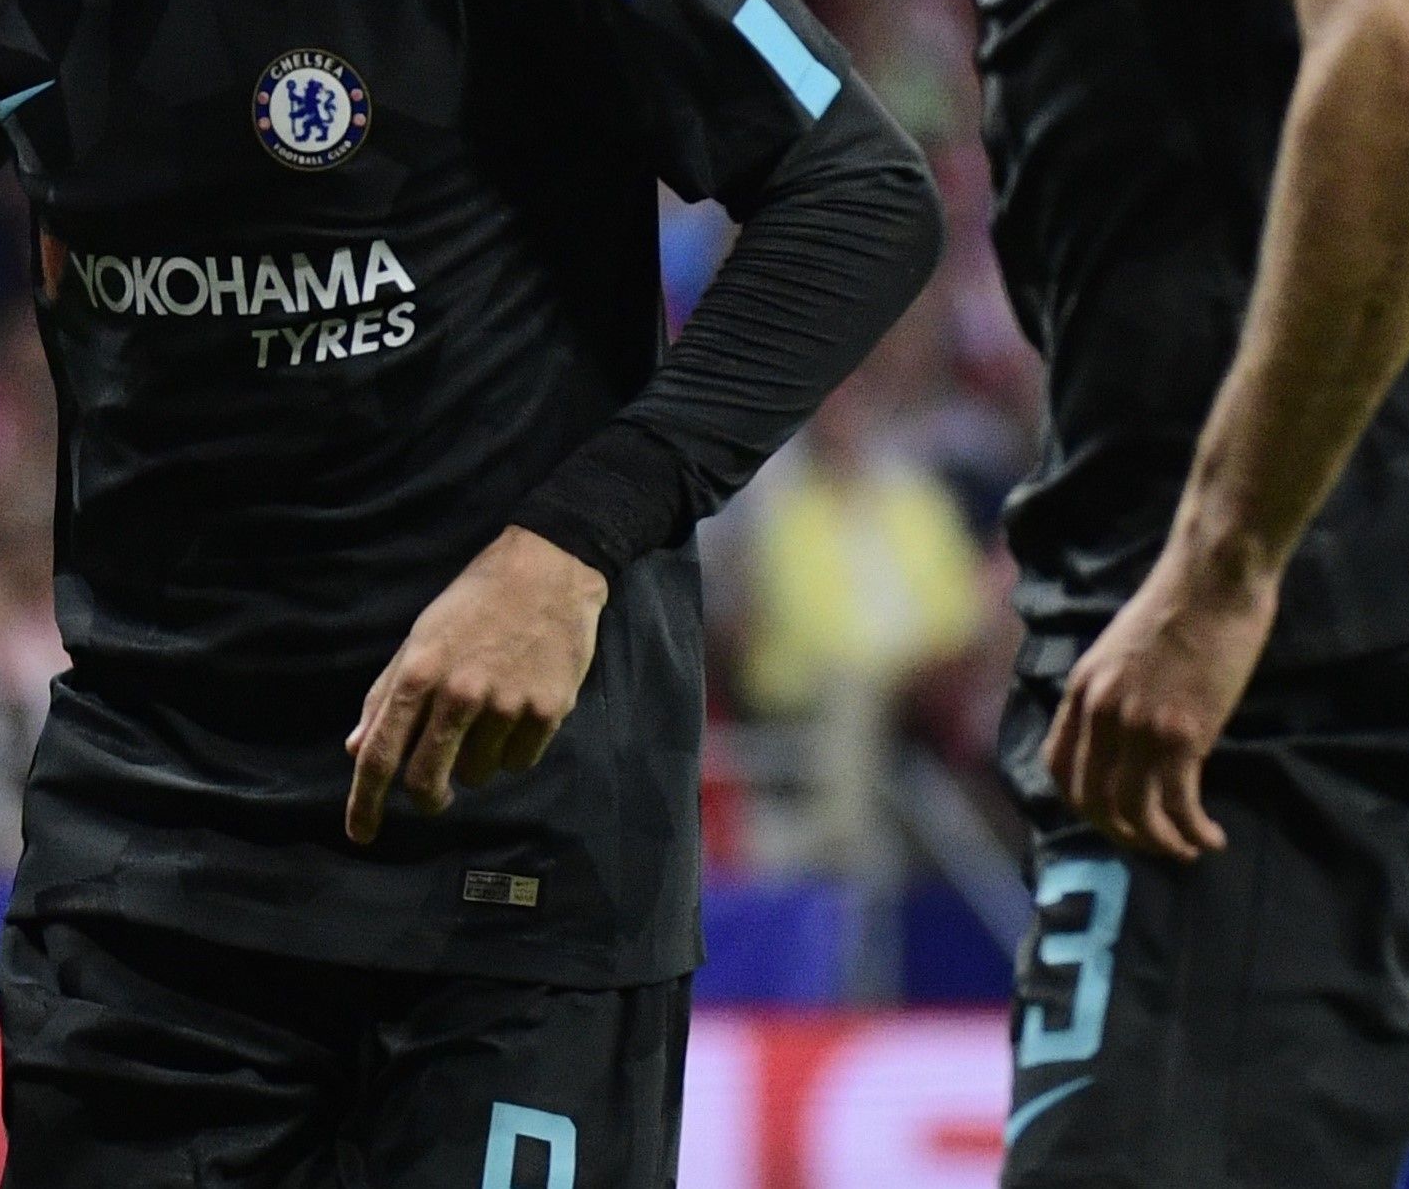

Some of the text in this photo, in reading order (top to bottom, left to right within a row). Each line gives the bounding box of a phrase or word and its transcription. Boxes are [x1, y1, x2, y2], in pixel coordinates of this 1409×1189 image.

[270, 52, 344, 80] CHELSEA
[70, 238, 416, 316] YOKOHAMA
[251, 302, 416, 369] TYRES
[1018, 859, 1132, 1069] 3
